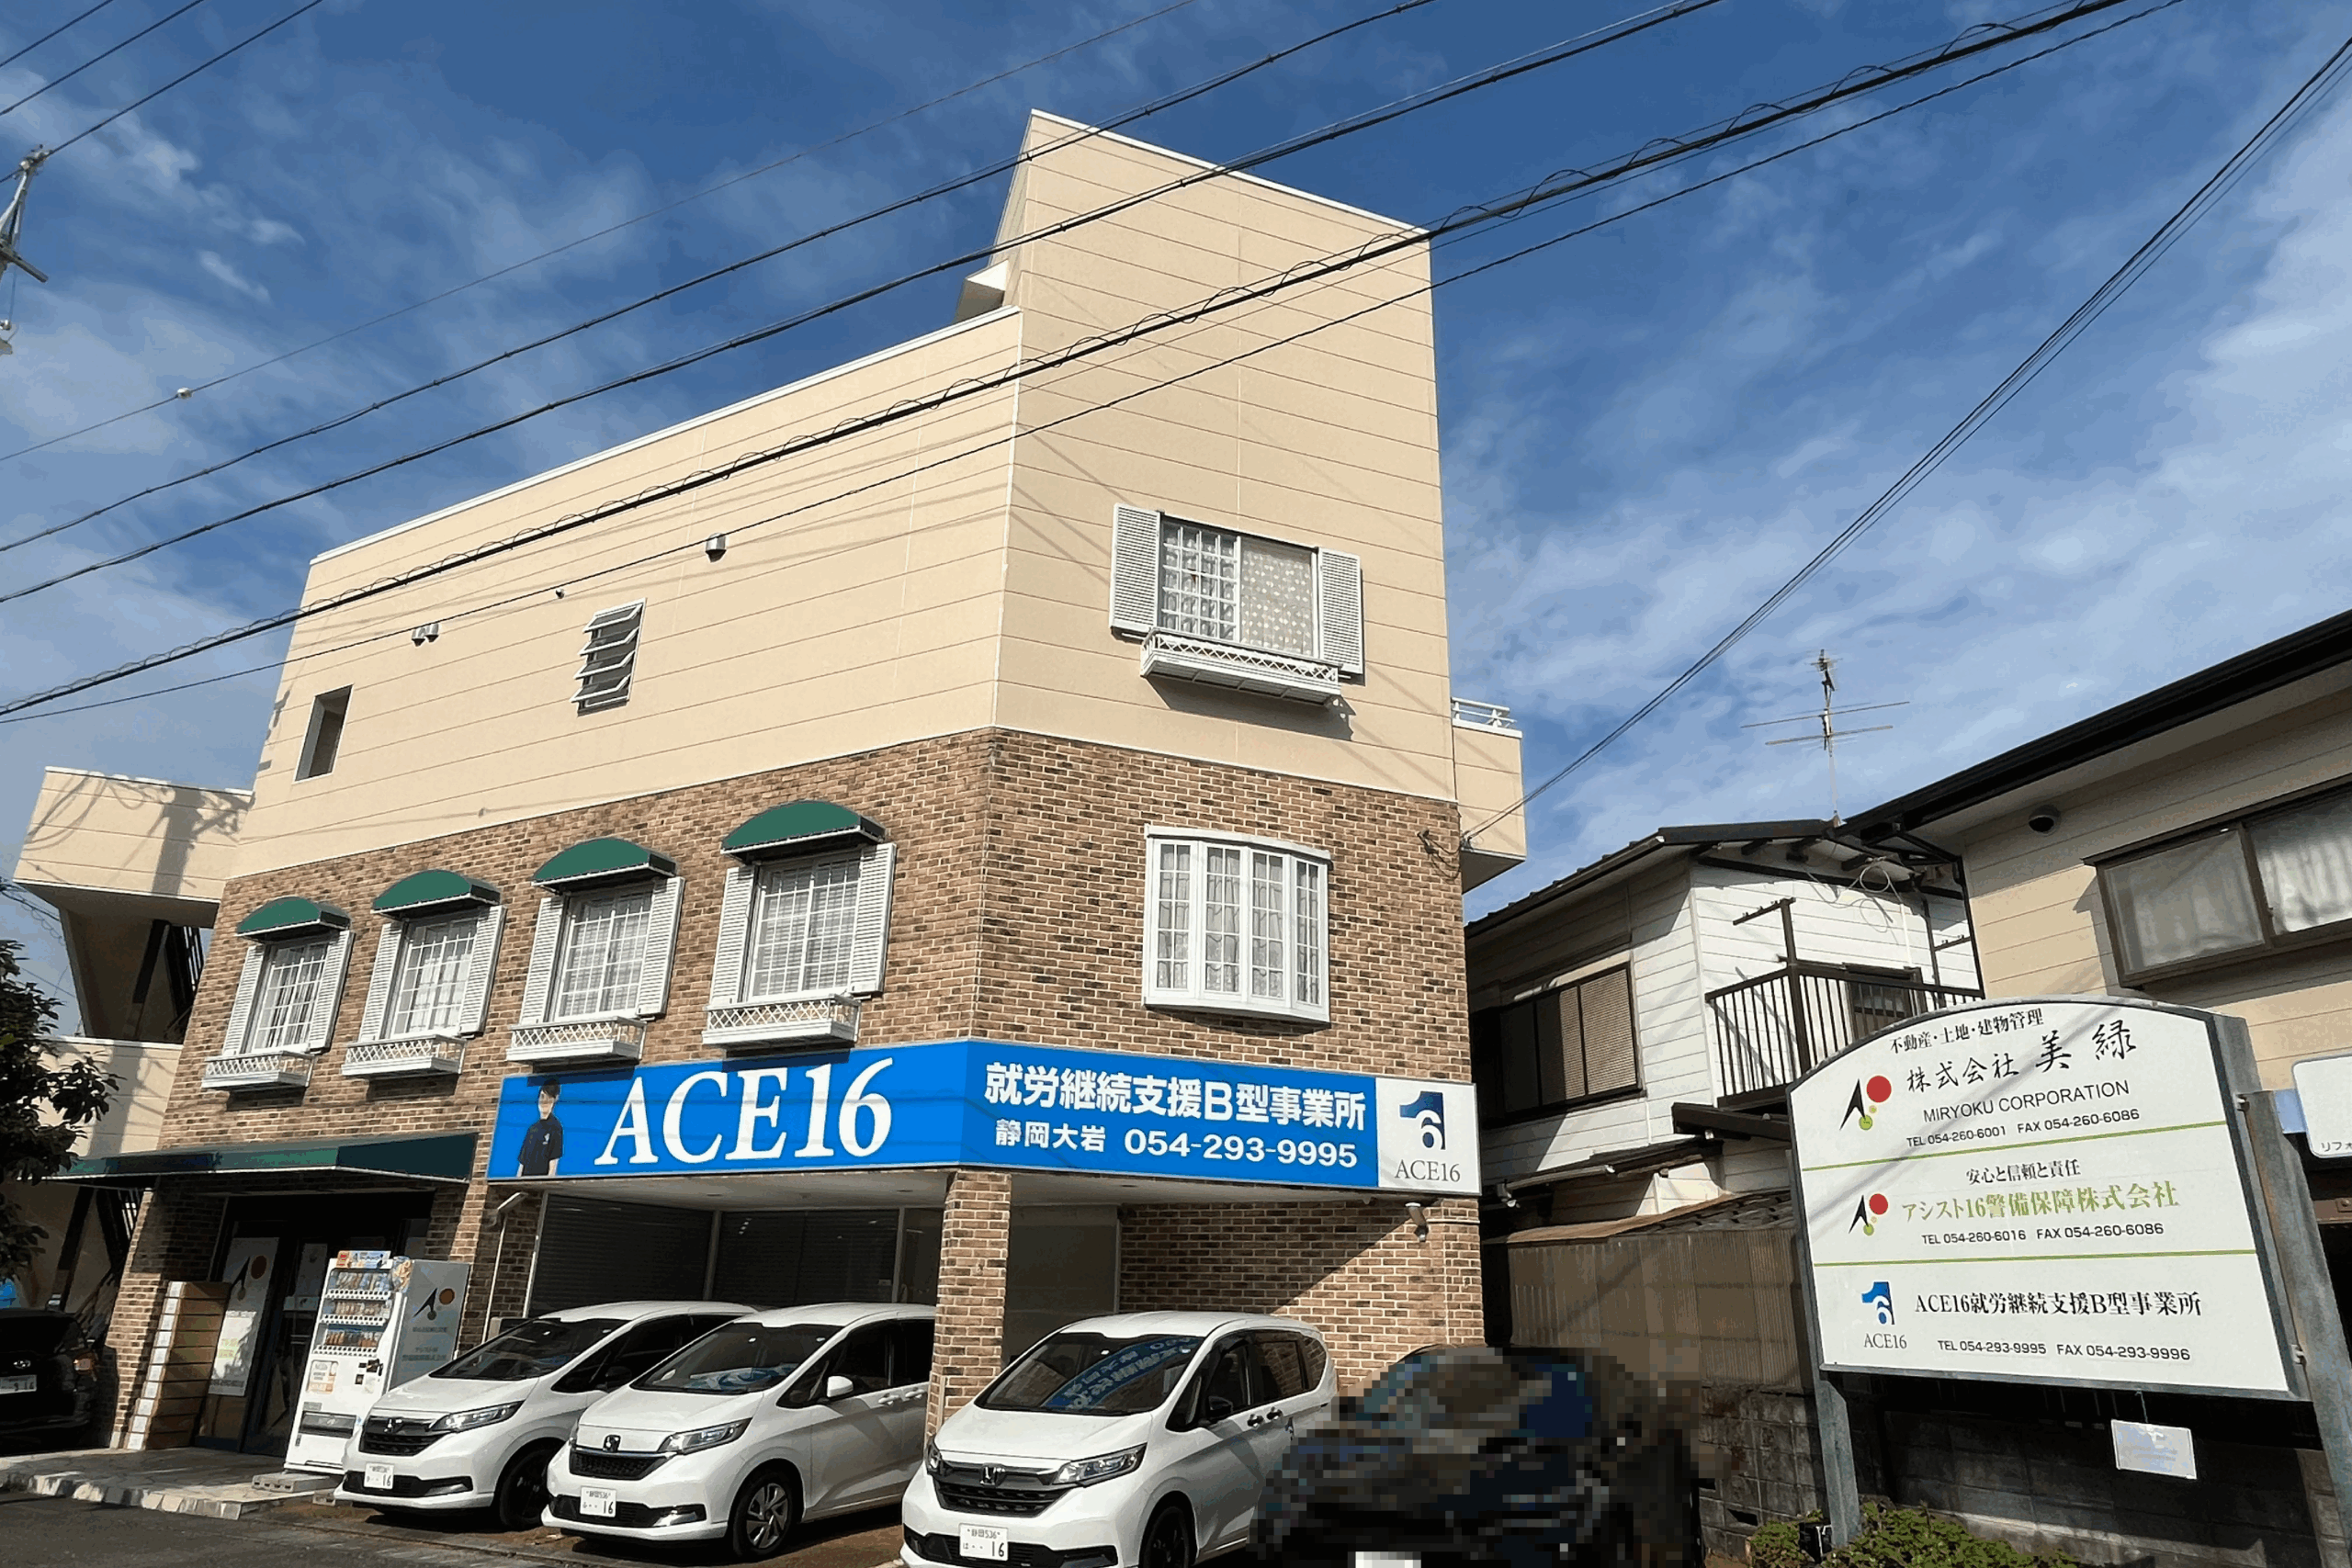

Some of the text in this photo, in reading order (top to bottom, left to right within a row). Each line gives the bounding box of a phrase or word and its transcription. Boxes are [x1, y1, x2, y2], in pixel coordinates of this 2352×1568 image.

[1906, 1053, 2019, 1093] 株式会社
[594, 1057, 894, 1166] ACE16
[984, 1062, 1367, 1132] 就労継続支援B型事業所
[1923, 1079, 2130, 1122] MIRYOKU CORPORATION
[995, 1118, 1358, 1168] 静岡大岩 054-293-9995
[1906, 1108, 2141, 1147] TEL 054-260-6001 FAX 054-260-6086
[1395, 1159, 1461, 1182] ACE16
[1965, 1158, 2081, 1185] 安心と信頼と責任
[1902, 1180, 2181, 1223] アシスト16警備保障株式会社
[1922, 1223, 2164, 1245] TEL 054-260-6016 FAX 054-260-6086
[1915, 1291, 2202, 1316] ACE16就労継続支援B型事業所
[1863, 1333, 1907, 1349] ACE16
[1938, 1339, 2191, 1361] TEL 054-293-9995 FAX 054-293-9996
